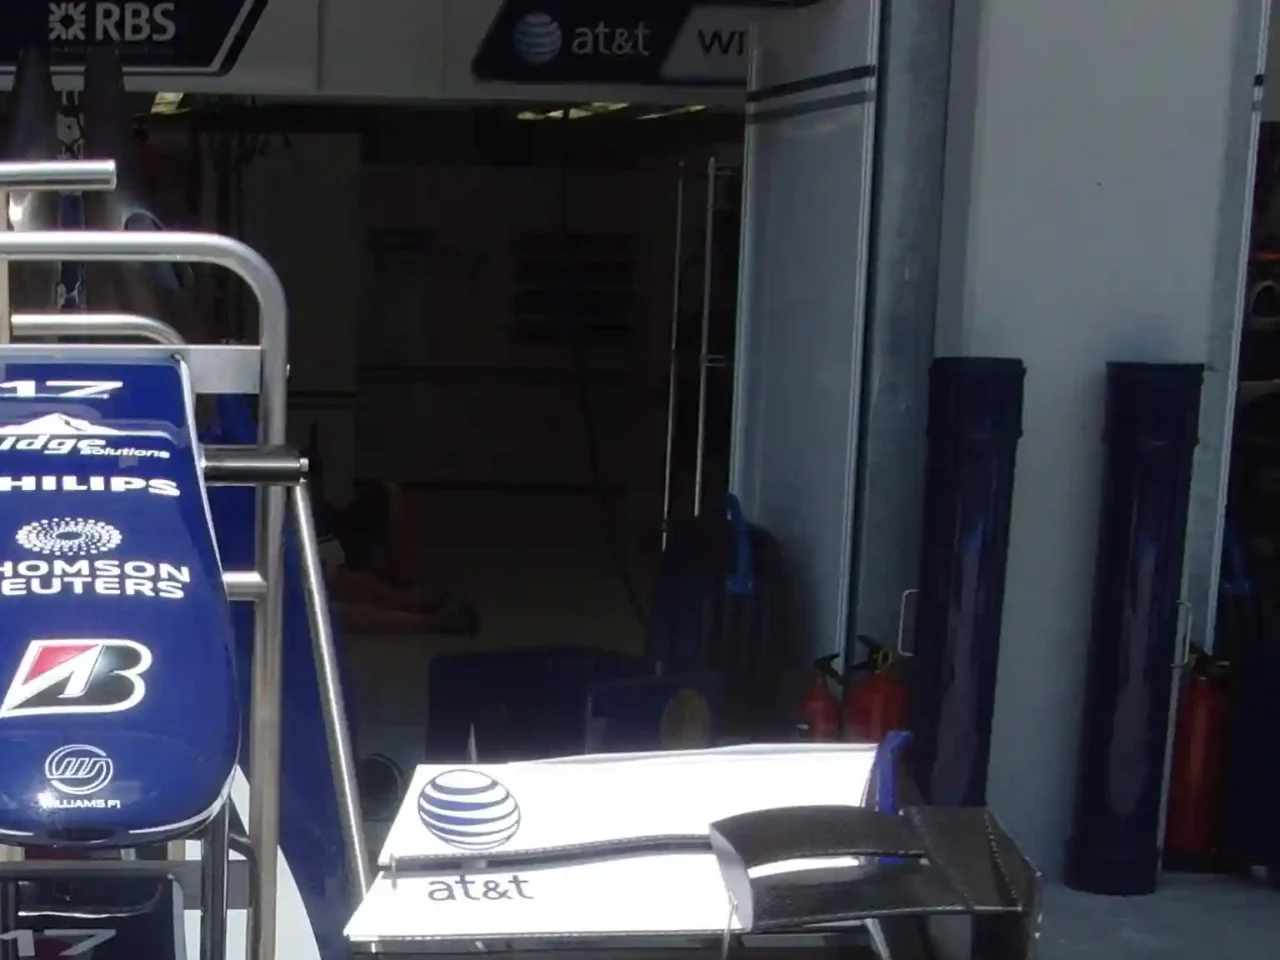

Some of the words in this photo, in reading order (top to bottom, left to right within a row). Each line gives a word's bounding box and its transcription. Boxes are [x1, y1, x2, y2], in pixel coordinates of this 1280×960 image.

[96, 2, 176, 41] RBS
[571, 21, 652, 56] at&t
[427, 874, 534, 901] at&t
